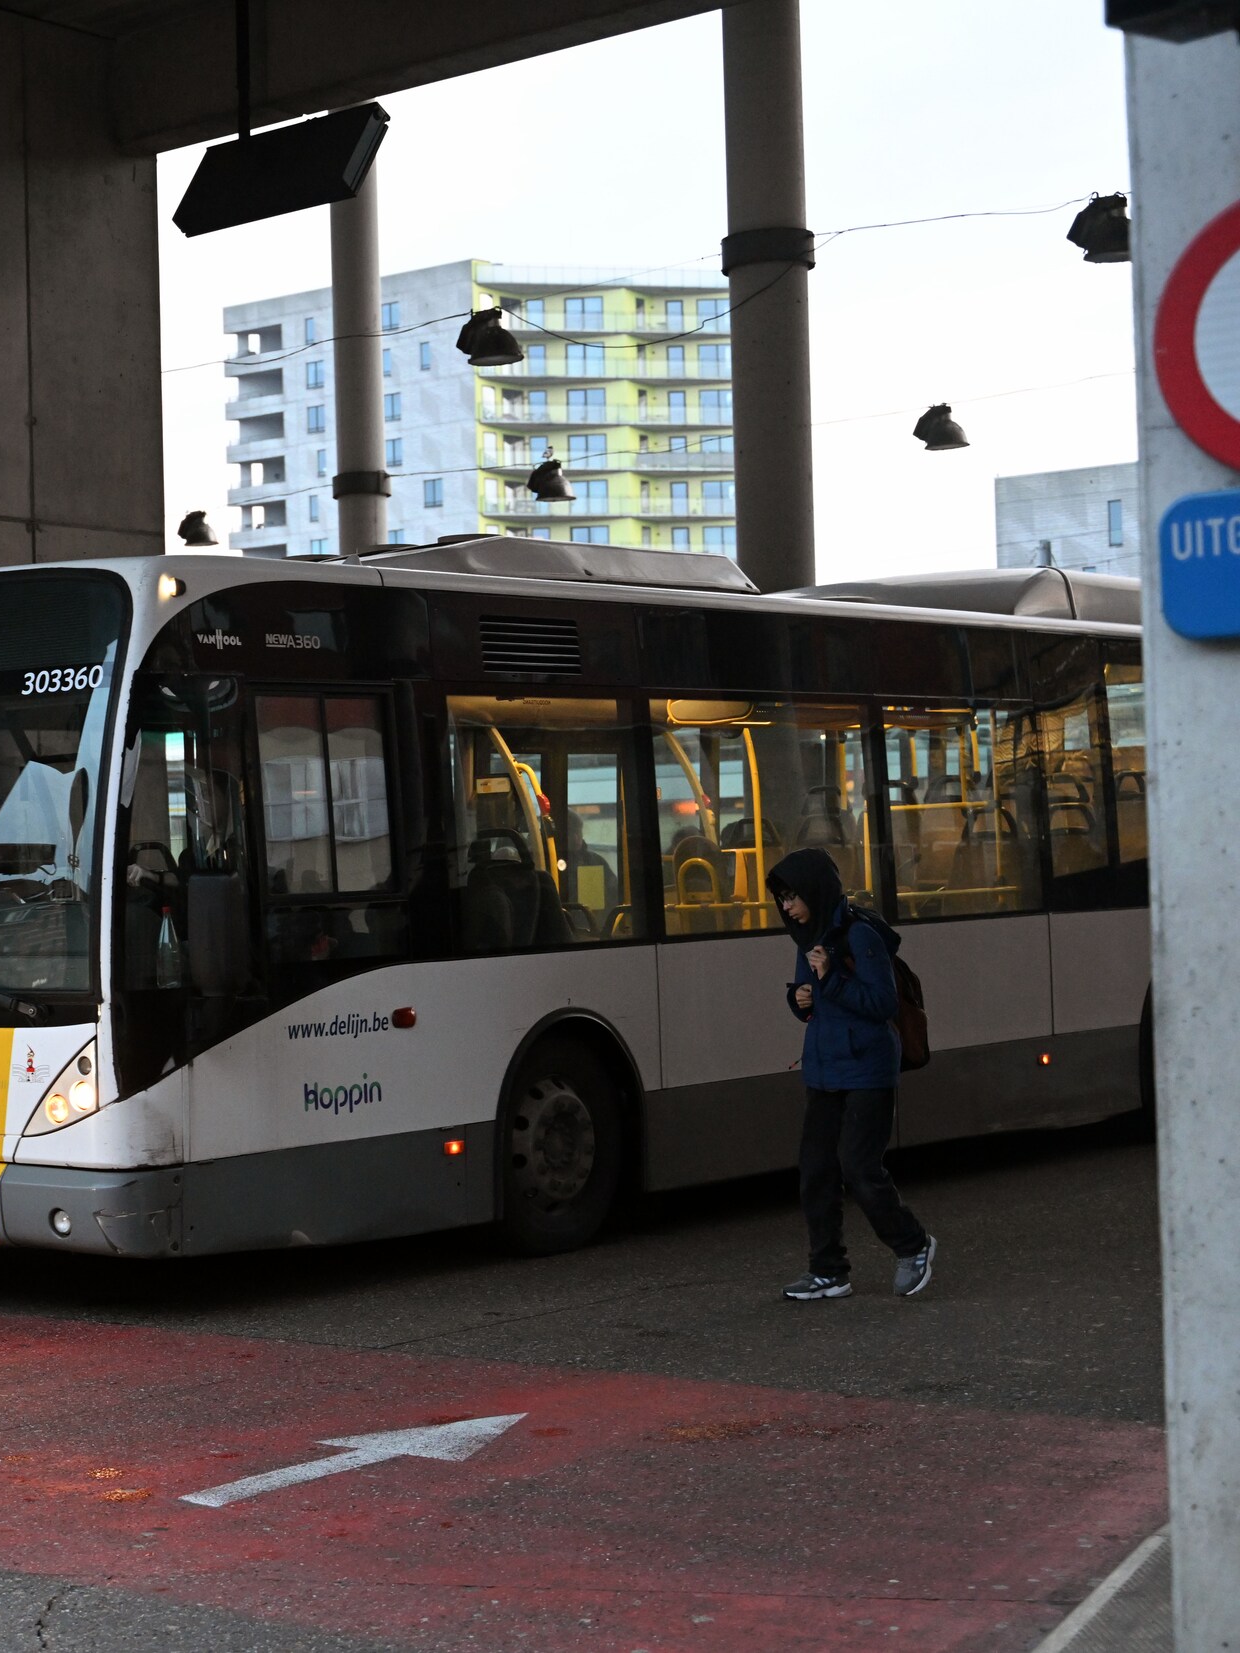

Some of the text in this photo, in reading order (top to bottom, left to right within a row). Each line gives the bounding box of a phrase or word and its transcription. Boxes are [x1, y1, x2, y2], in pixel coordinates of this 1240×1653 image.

[21, 664, 104, 695] 303360
[288, 1011, 389, 1039] www.delijn.be
[304, 1072, 382, 1115] Hoppin
